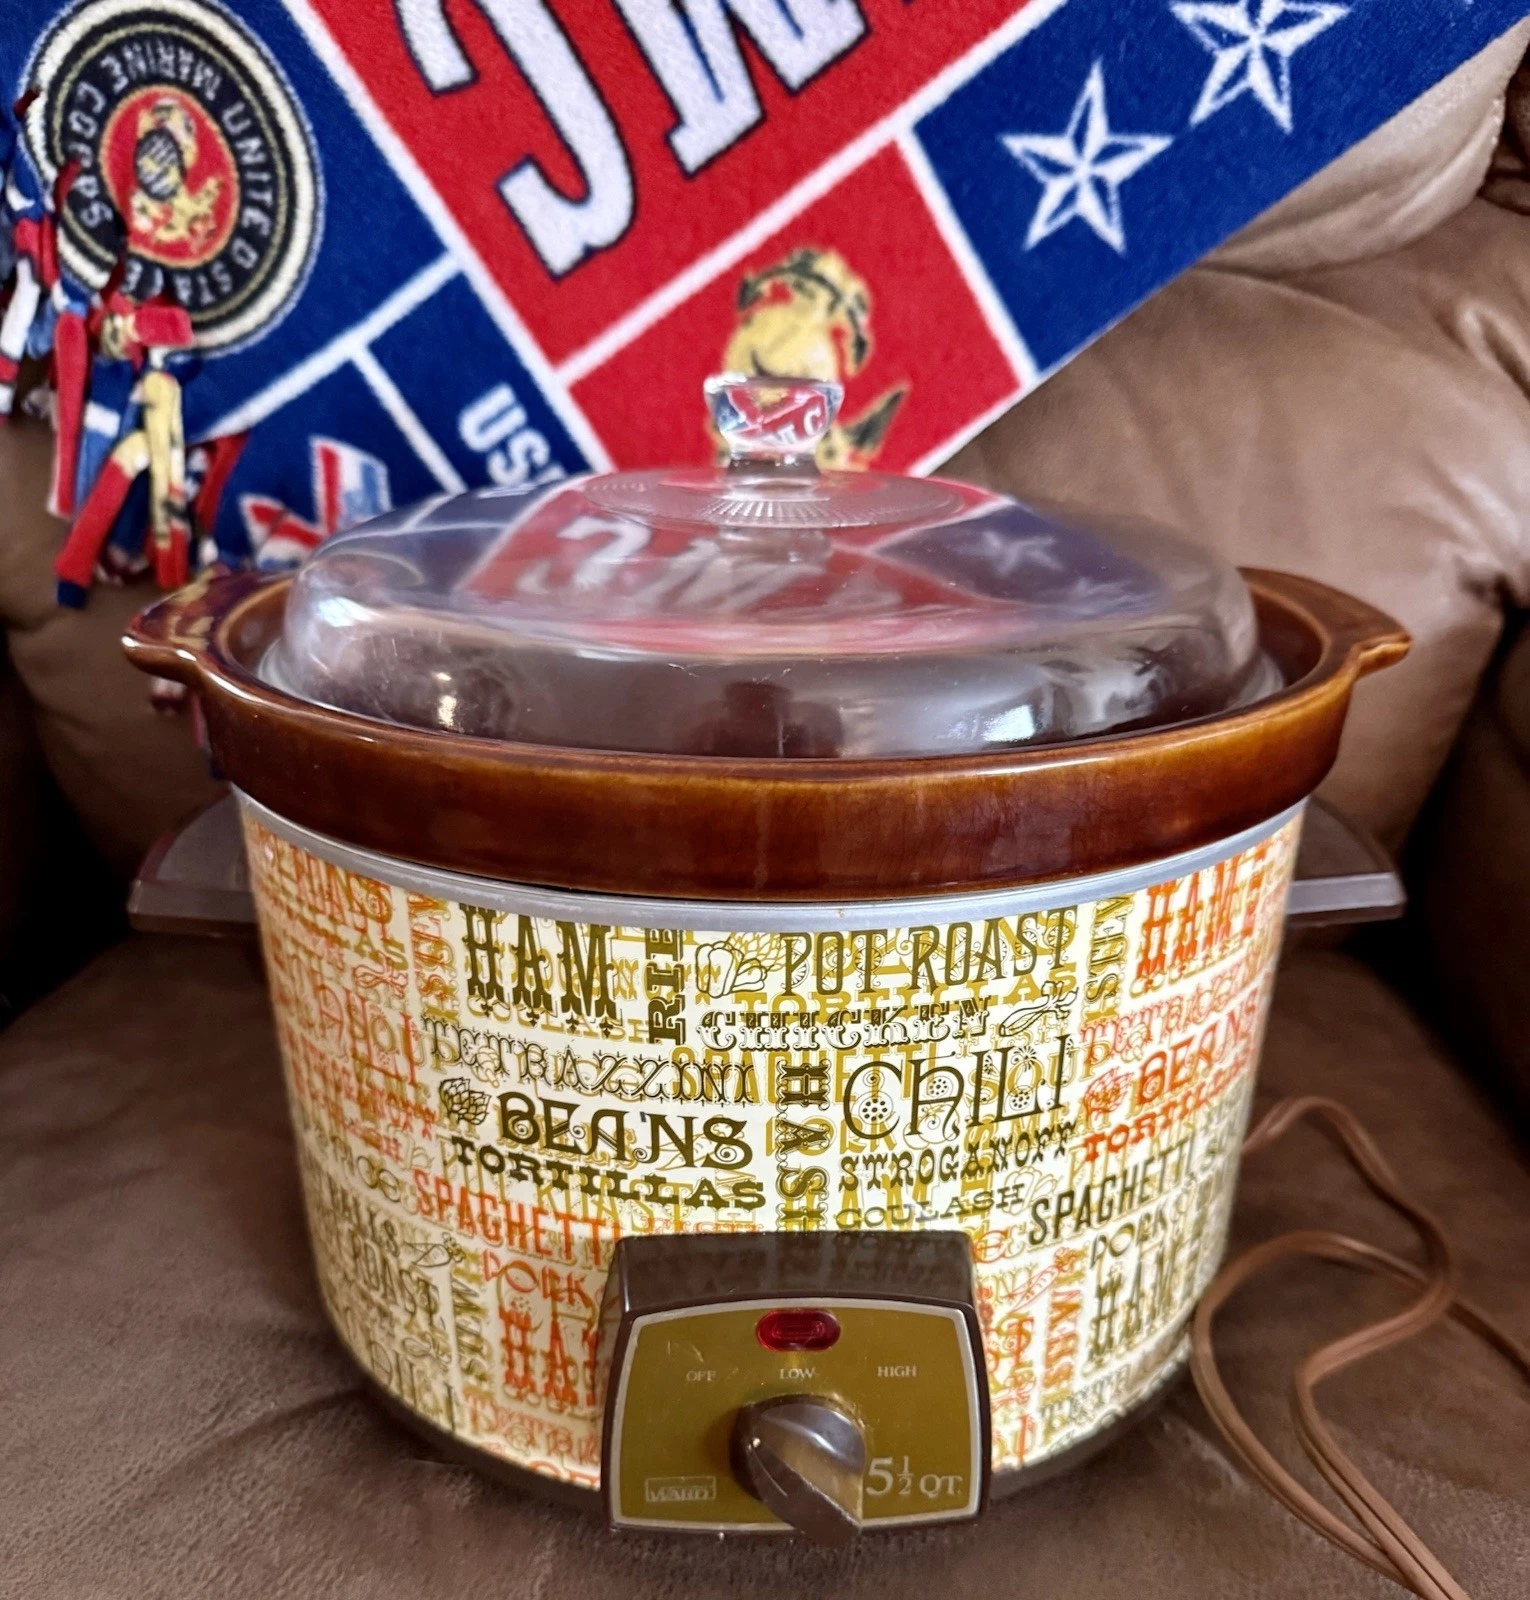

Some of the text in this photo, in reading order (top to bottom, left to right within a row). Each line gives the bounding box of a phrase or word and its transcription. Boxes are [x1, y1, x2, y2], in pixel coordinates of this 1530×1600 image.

[98, 40, 222, 102] MARINE
[221, 102, 271, 271] UNITED
[459, 903, 617, 1022] HAM
[779, 905, 1078, 997] POT ROAST
[696, 995, 992, 1051] CHICKEN
[496, 1092, 755, 1171] BEANS
[837, 1119, 1077, 1193] STROGANOFF
[449, 1134, 767, 1212] TORTILLAS
[834, 1180, 1025, 1230] GOULASH
[779, 1367, 815, 1380] LOW
[877, 1364, 917, 1377] HIGH
